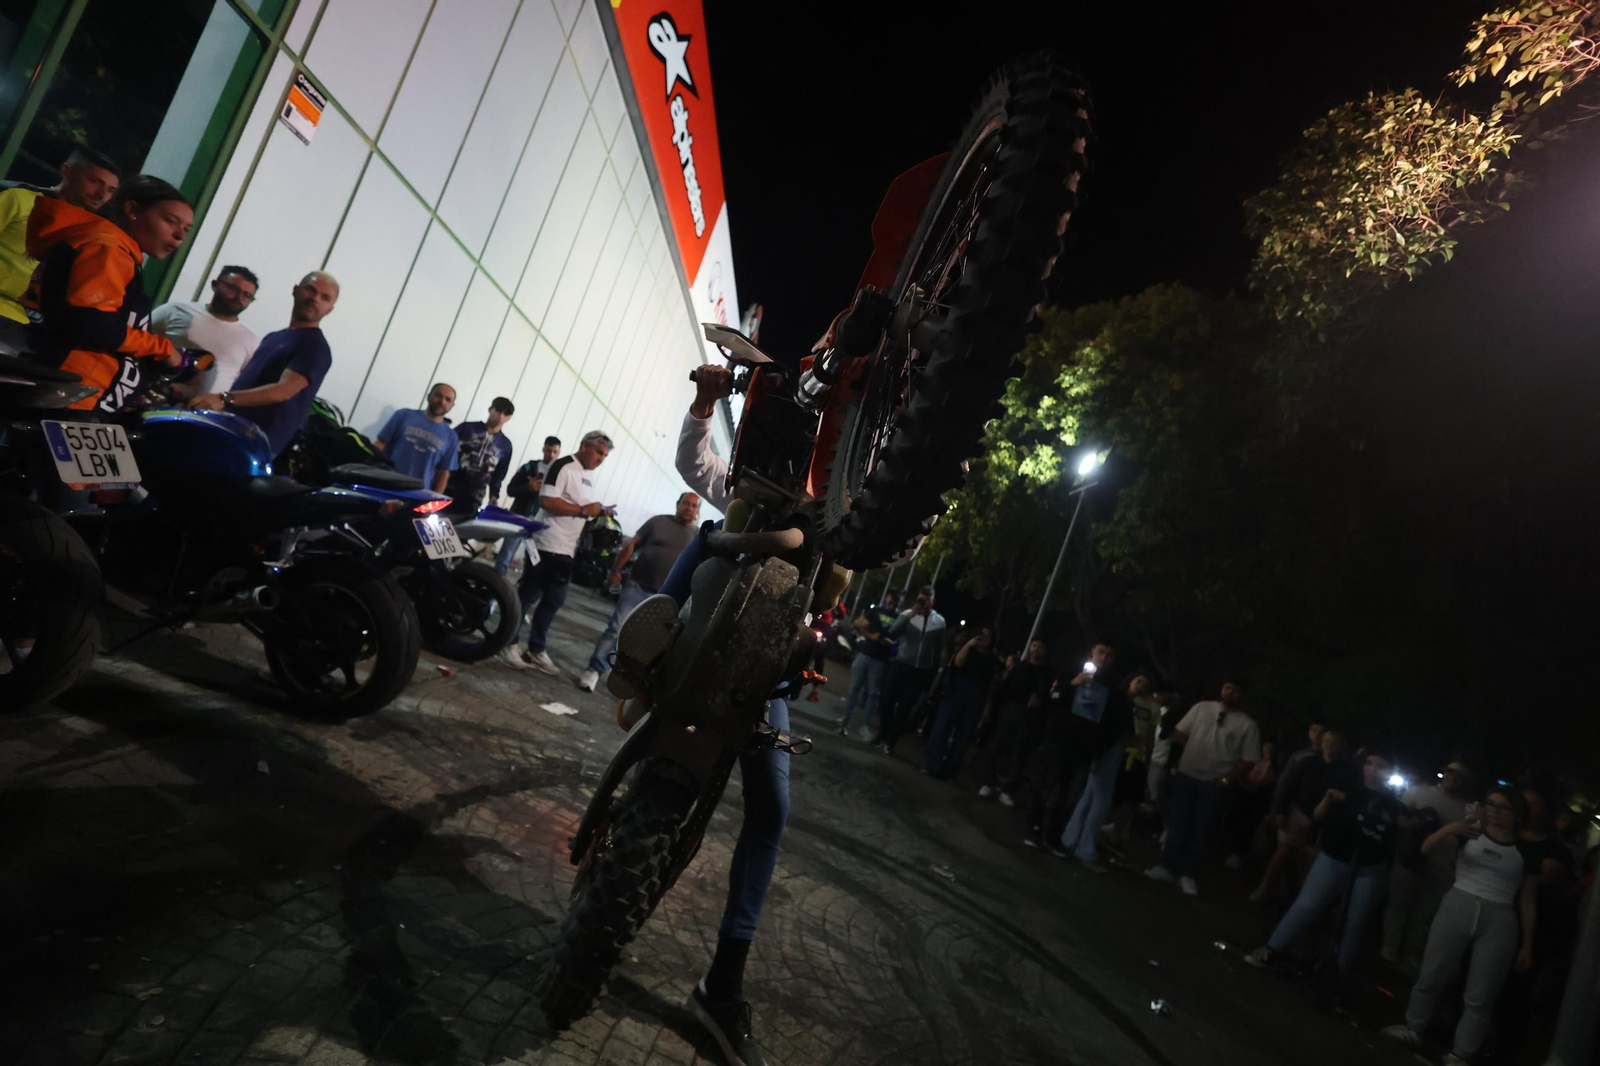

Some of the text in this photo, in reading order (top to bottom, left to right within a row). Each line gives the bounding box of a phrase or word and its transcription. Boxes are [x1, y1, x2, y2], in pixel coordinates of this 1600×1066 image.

[65, 426, 125, 451] 5504
[74, 453, 120, 477] LBW
[432, 538, 456, 555] DXG
